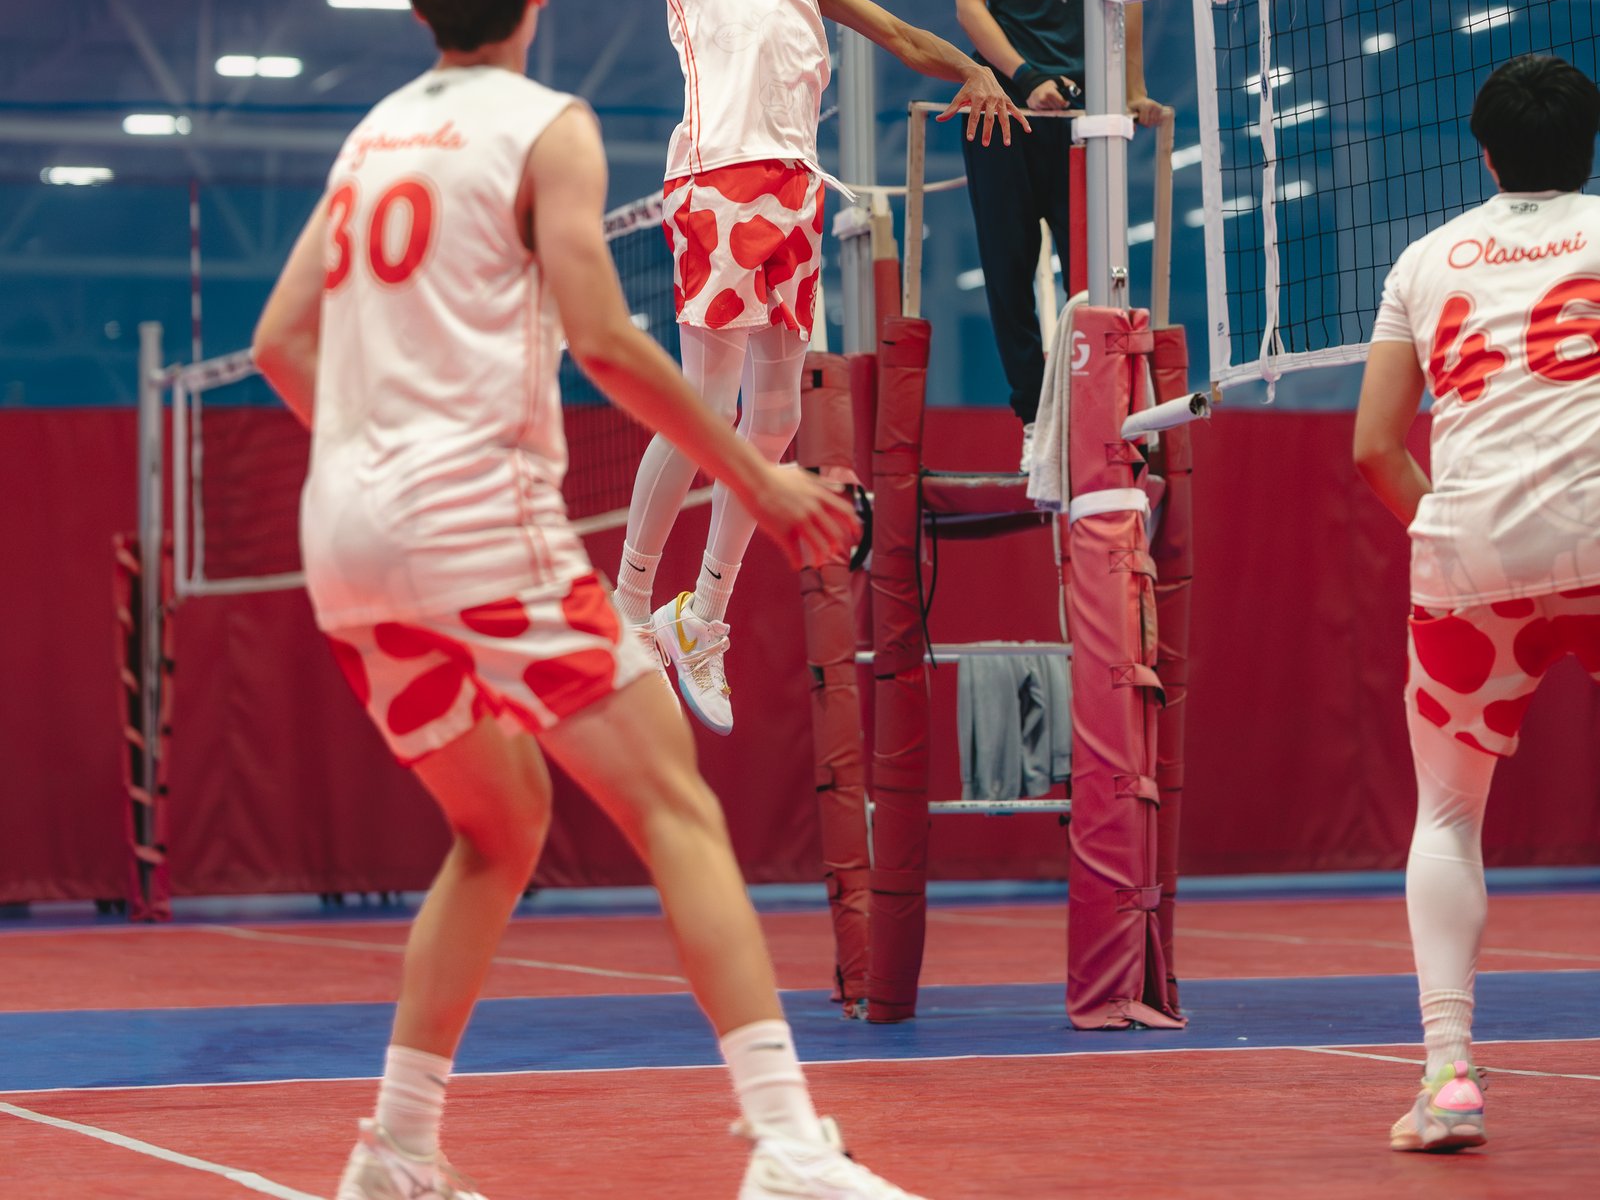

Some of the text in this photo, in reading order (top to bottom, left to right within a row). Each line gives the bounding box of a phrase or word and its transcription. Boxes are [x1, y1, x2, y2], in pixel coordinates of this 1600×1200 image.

[324, 174, 439, 292] 30
[1447, 231, 1588, 269] Olavarri
[1428, 272, 1600, 406] 46
